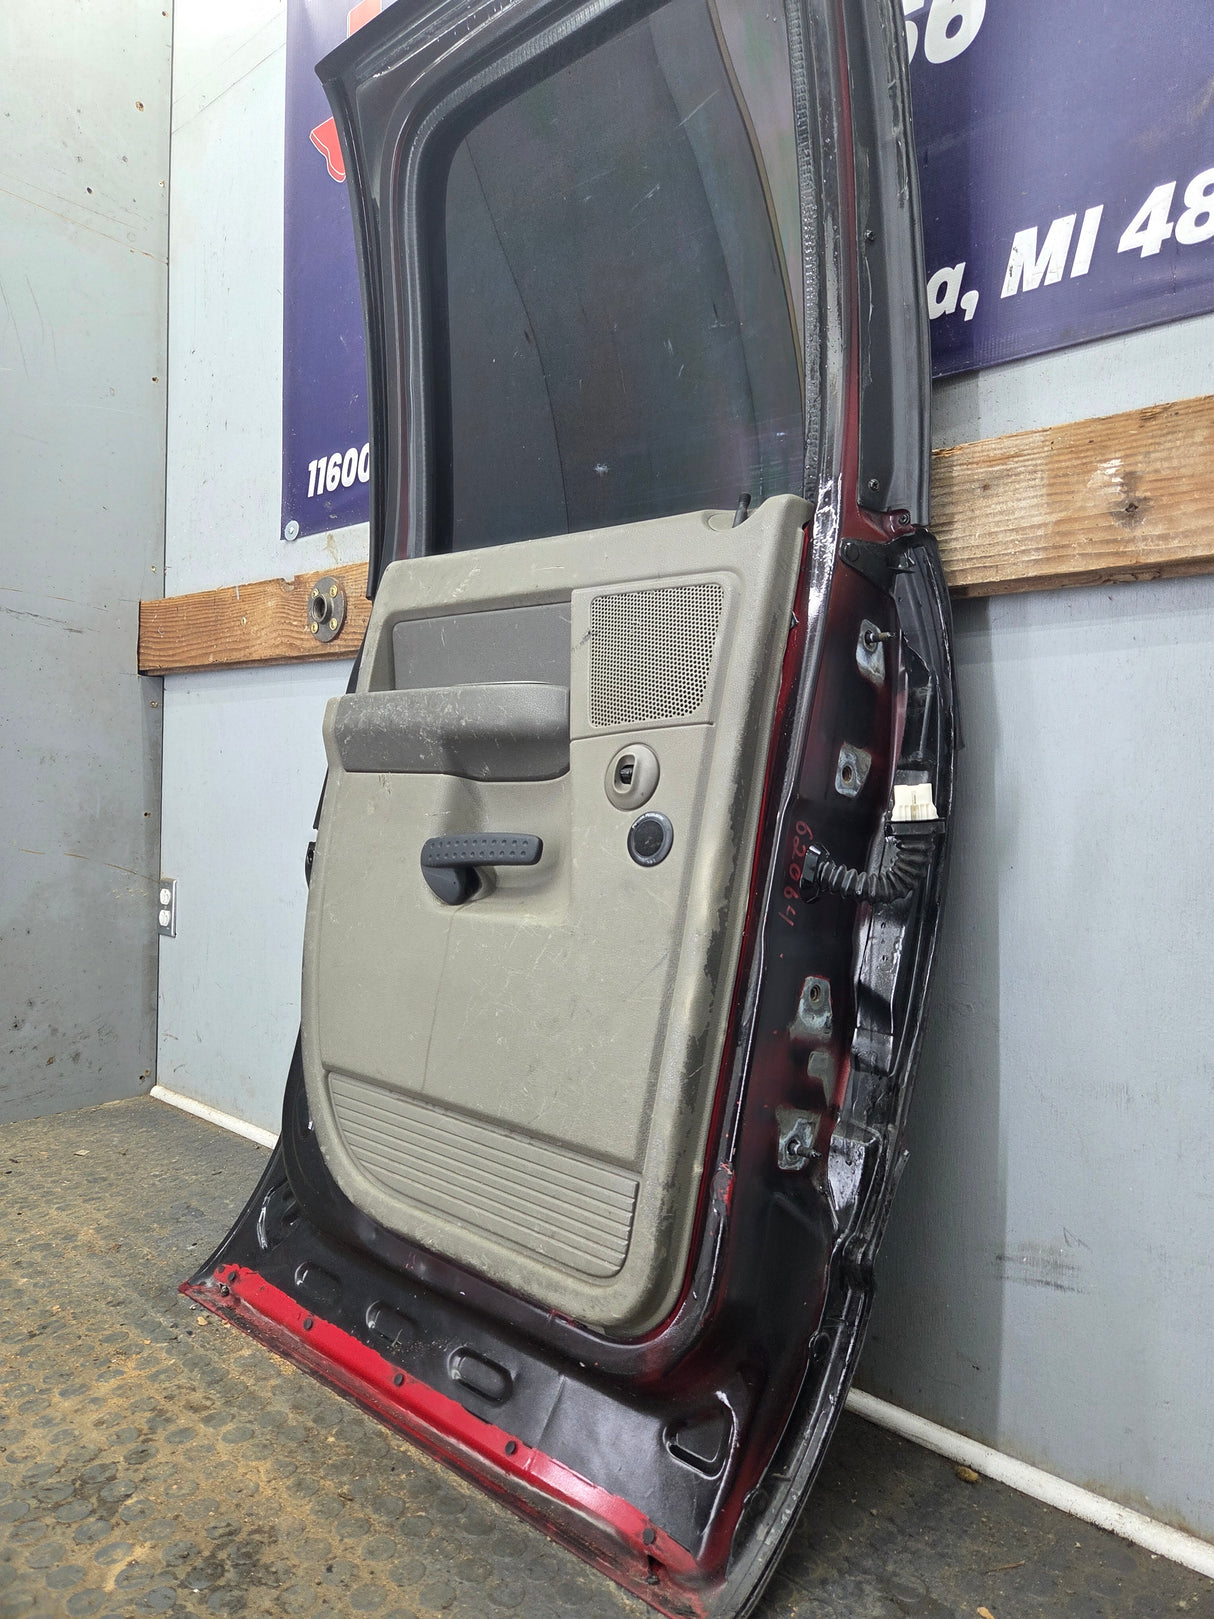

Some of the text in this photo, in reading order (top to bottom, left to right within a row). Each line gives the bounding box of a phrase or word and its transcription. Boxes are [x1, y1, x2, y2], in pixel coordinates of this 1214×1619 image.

[1000, 204, 1104, 299] MI
[1117, 167, 1214, 258] 48
[307, 442, 369, 498] 11600
